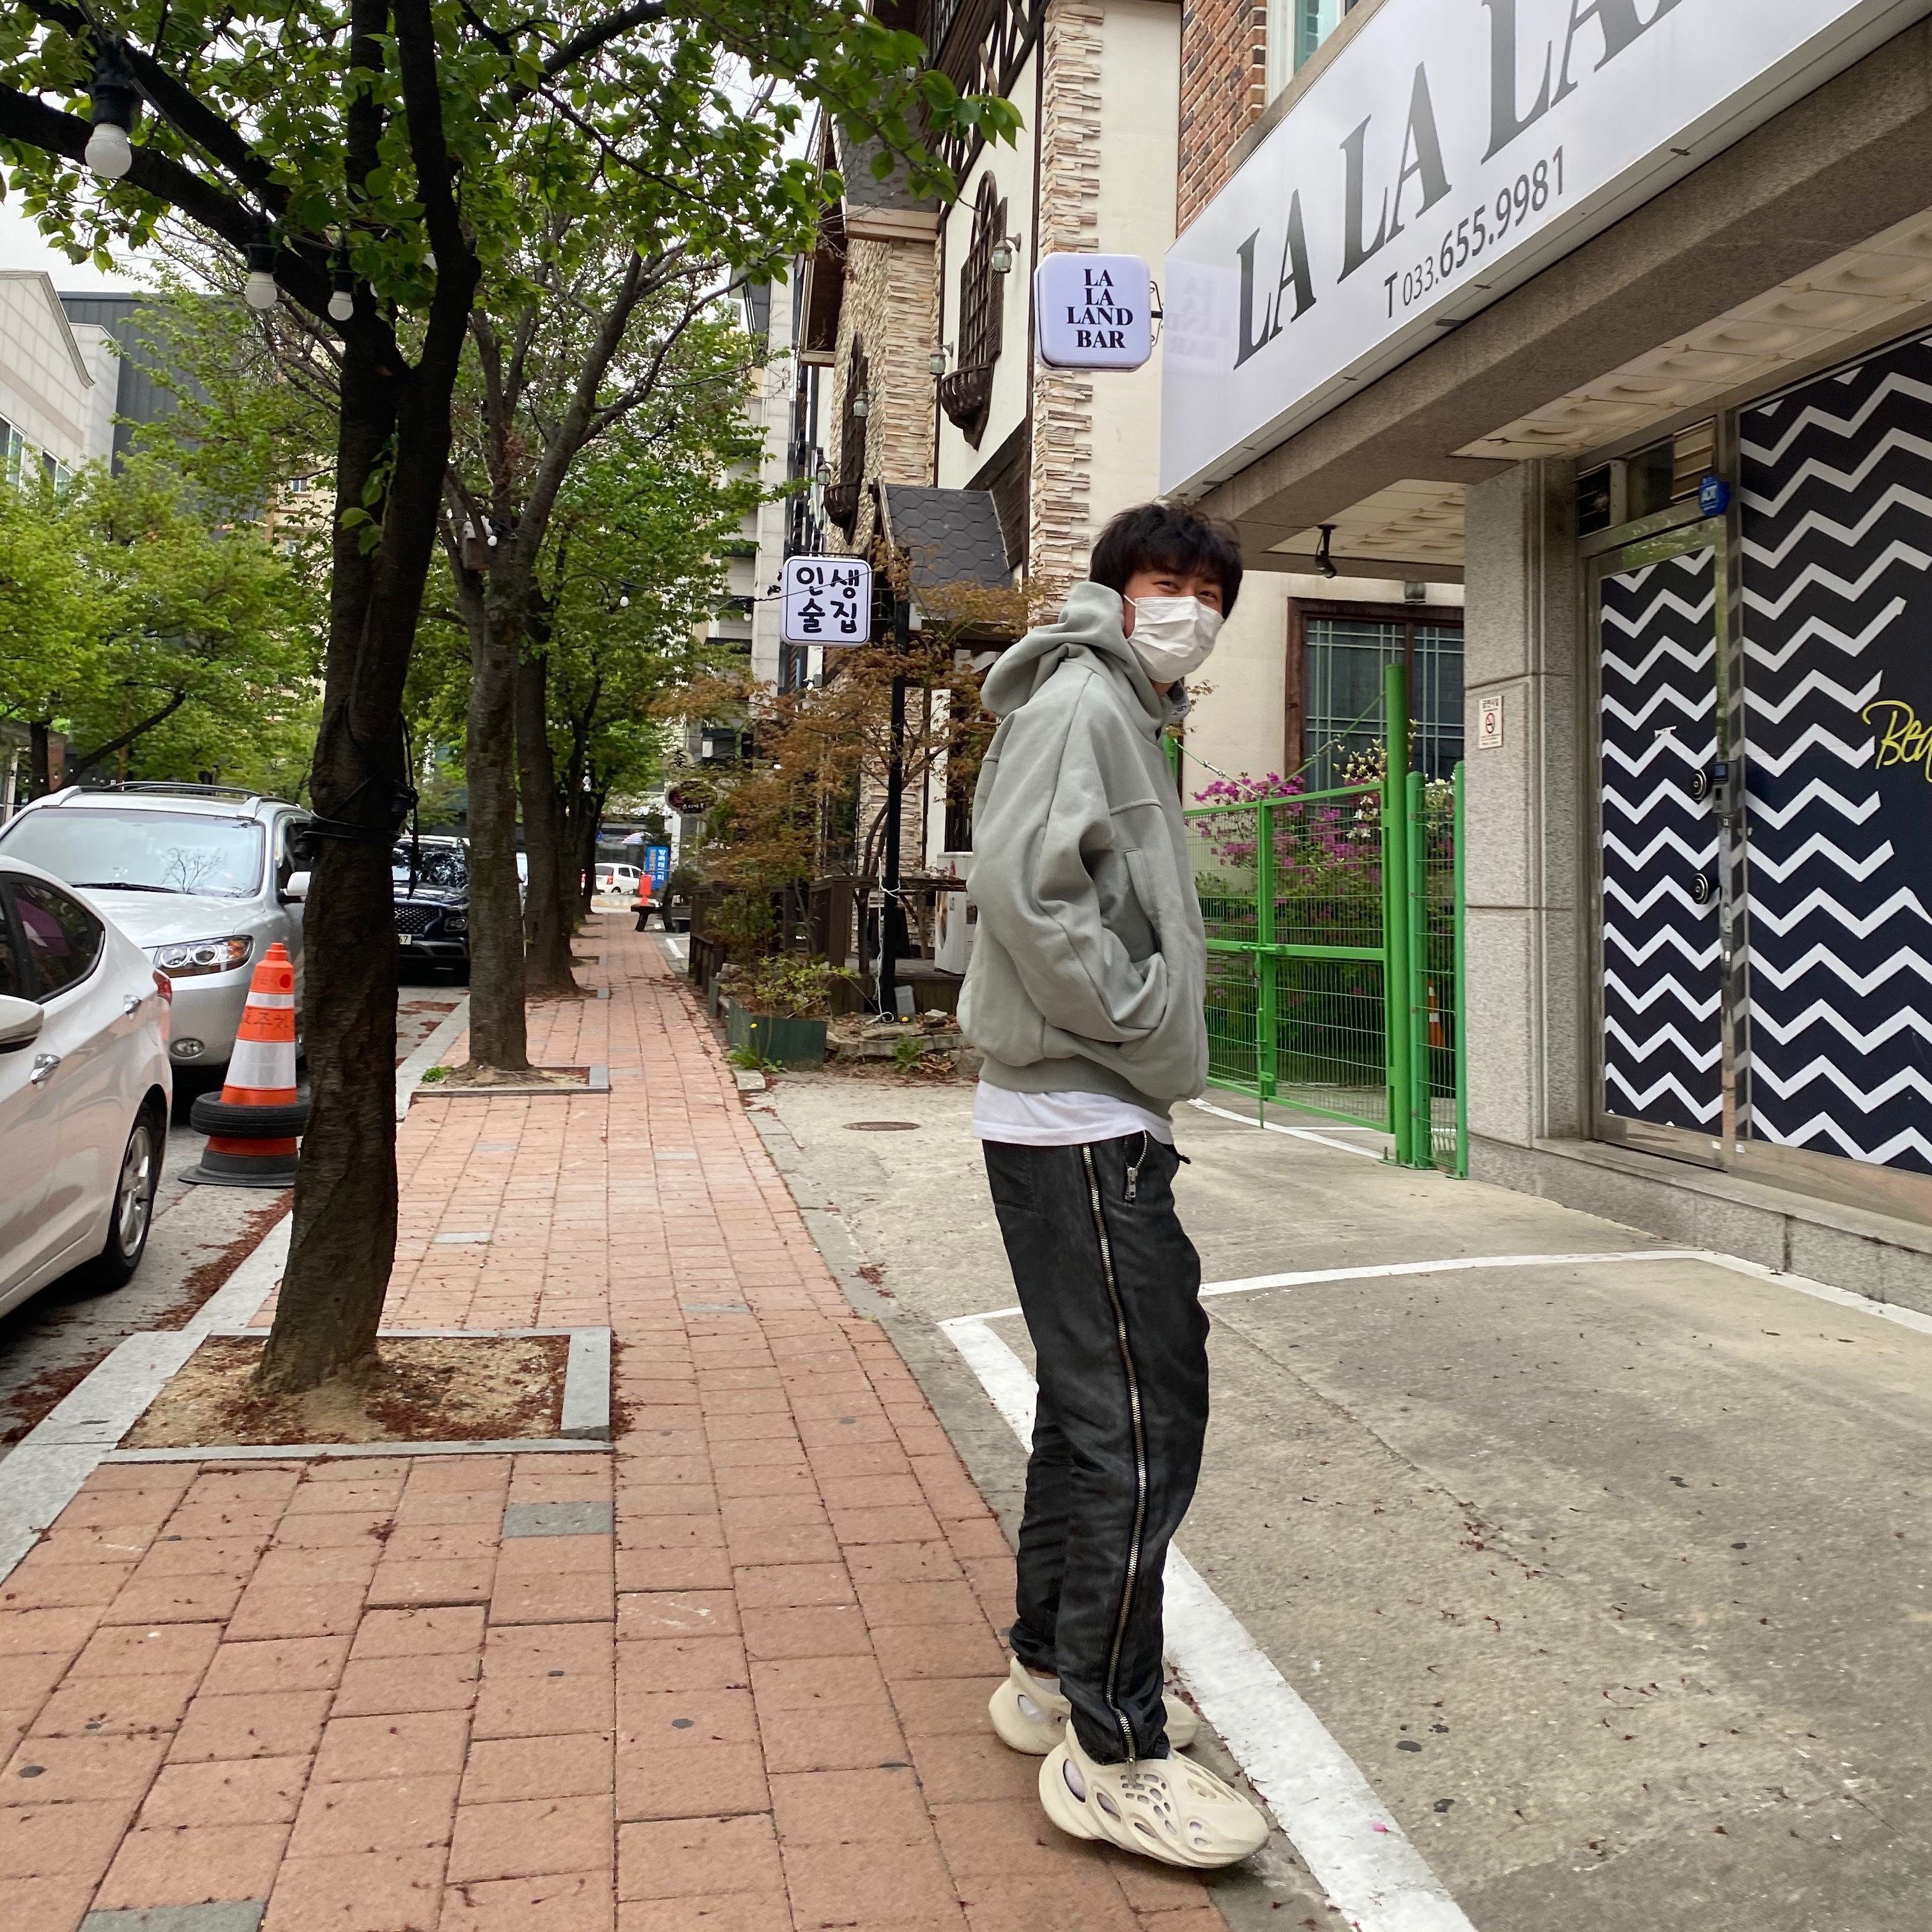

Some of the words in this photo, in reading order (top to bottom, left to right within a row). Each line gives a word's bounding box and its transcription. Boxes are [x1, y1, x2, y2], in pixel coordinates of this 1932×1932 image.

[1234, 188, 1317, 371] LA
[1337, 61, 1452, 284] LA
[1384, 272, 1398, 318] T
[1403, 145, 1563, 305] 033.655.9981
[1083, 268, 1114, 287] LA
[1084, 288, 1115, 306] LA
[1066, 307, 1133, 326] LAND
[1076, 330, 1126, 348] BAR
[797, 567, 859, 599] 인생
[798, 598, 857, 634] 술집
